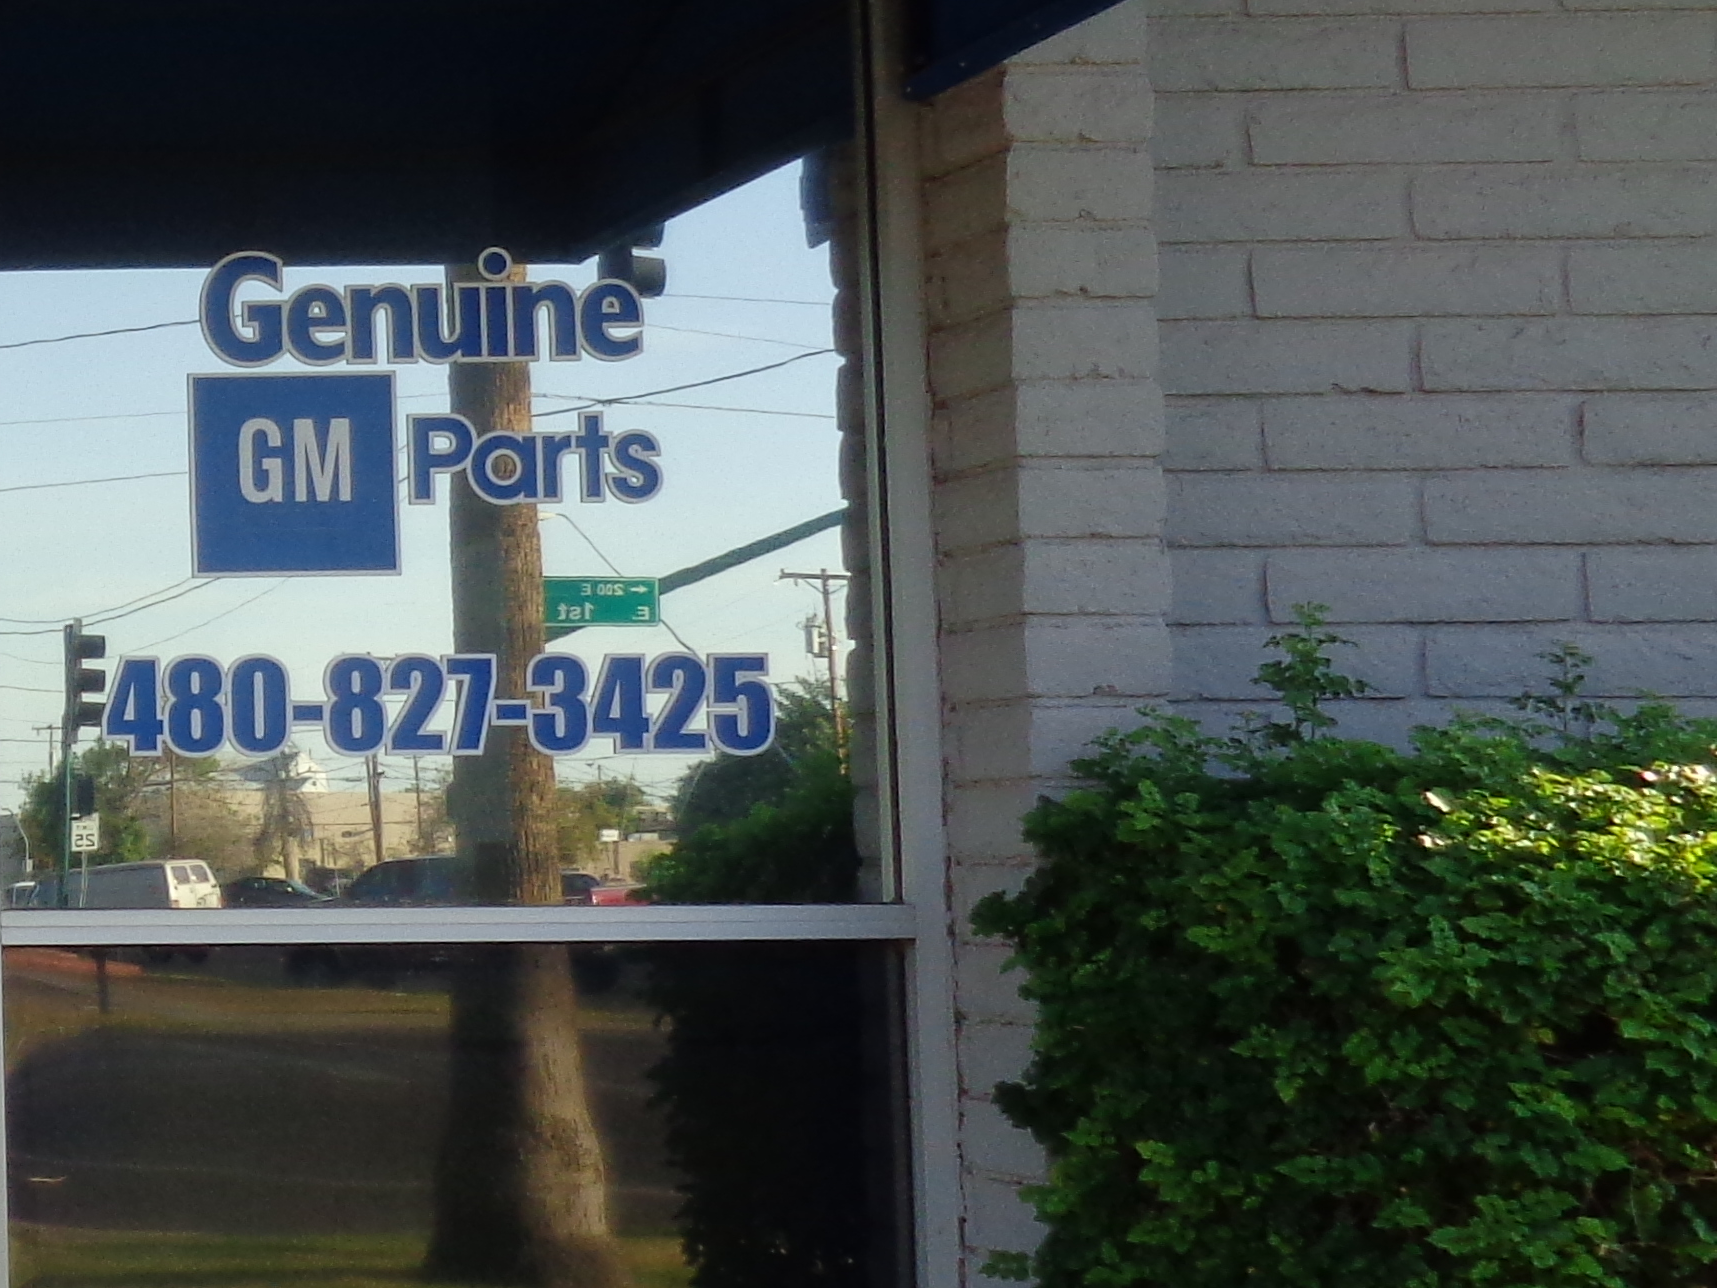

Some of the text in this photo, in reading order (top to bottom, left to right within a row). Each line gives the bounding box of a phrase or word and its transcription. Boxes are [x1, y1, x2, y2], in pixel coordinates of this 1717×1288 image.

[199, 247, 644, 367] Genuine
[238, 411, 662, 505] GM Parts
[101, 653, 776, 757] 480-827-3425
